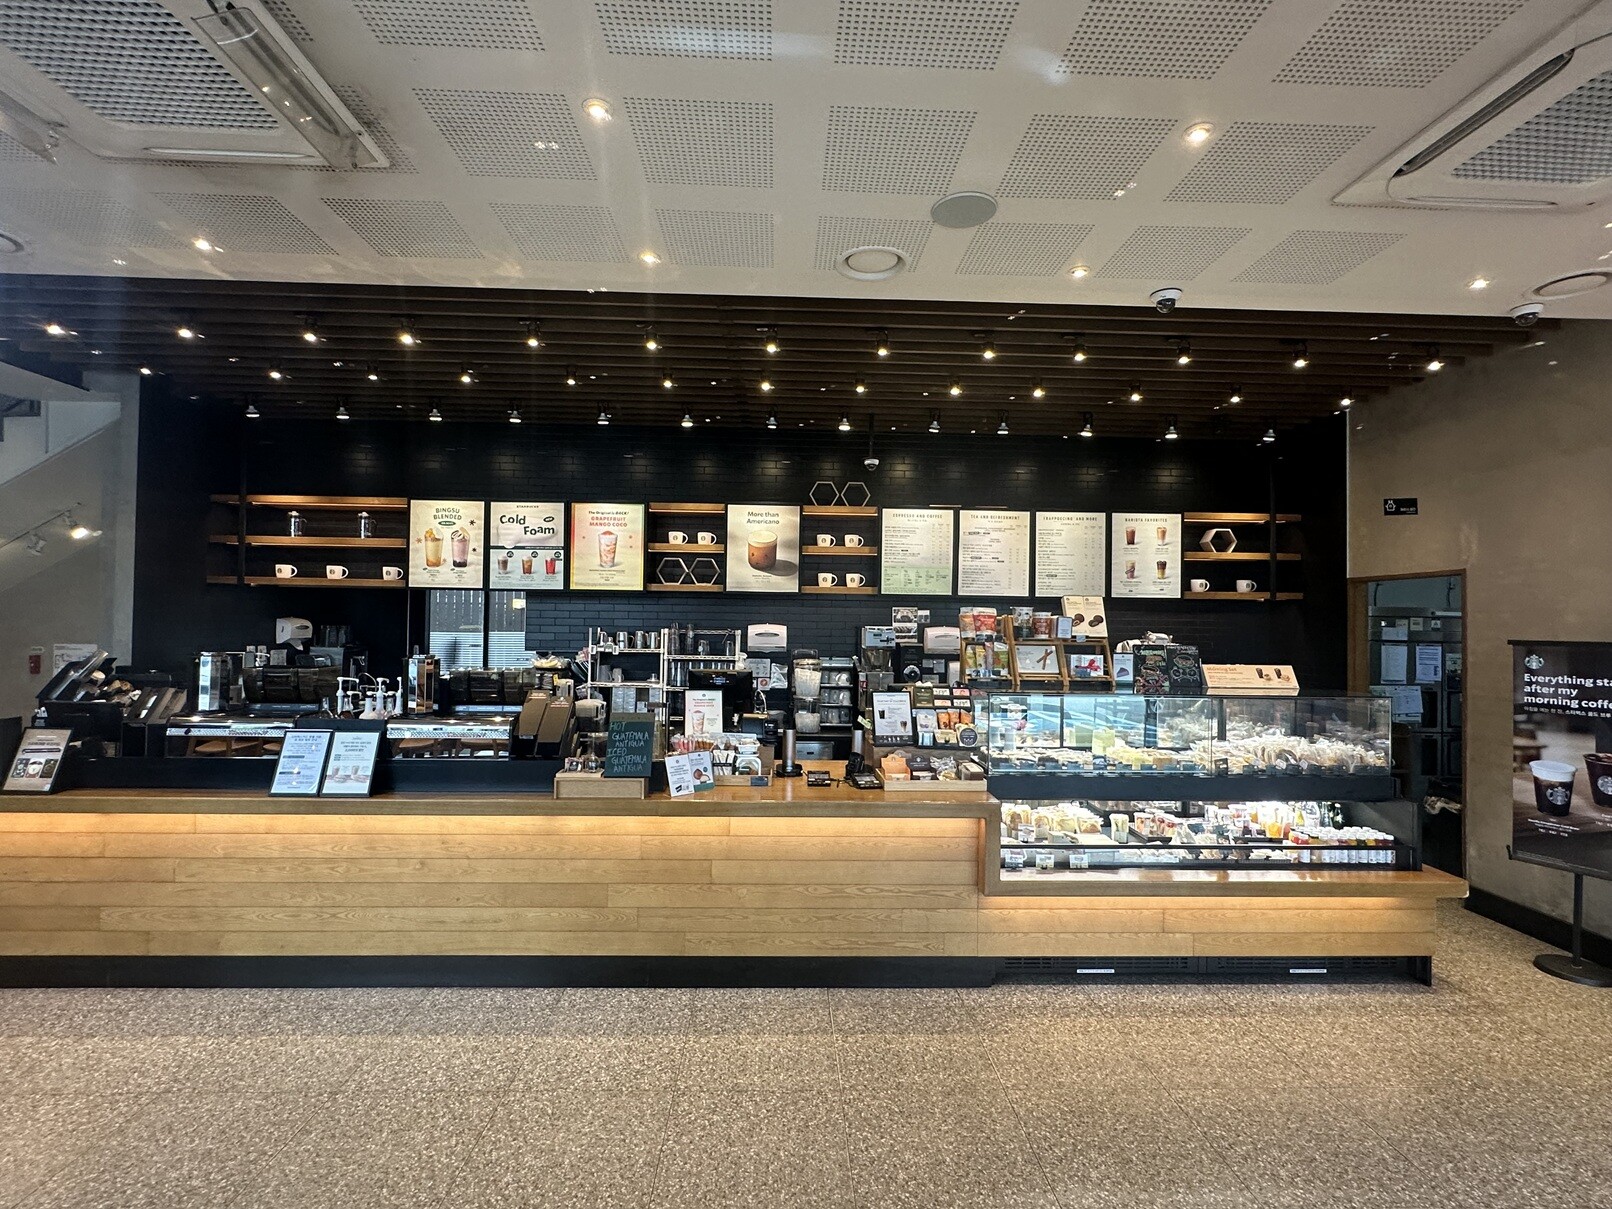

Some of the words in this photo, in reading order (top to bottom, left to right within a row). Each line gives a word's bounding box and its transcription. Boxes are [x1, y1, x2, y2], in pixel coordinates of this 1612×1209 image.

[499, 514, 526, 525] Cold
[523, 525, 555, 536] Foam
[1524, 674, 1593, 687] Everything
[1524, 684, 1555, 693] after
[1557, 687, 1578, 697] my
[1524, 696, 1579, 708] morning
[610, 721, 627, 731] HOT
[612, 731, 649, 740] GUATEMALA
[607, 748, 627, 757] ICED
[611, 755, 647, 765] GUATEMALA
[613, 764, 643, 773] ANTIGUA
